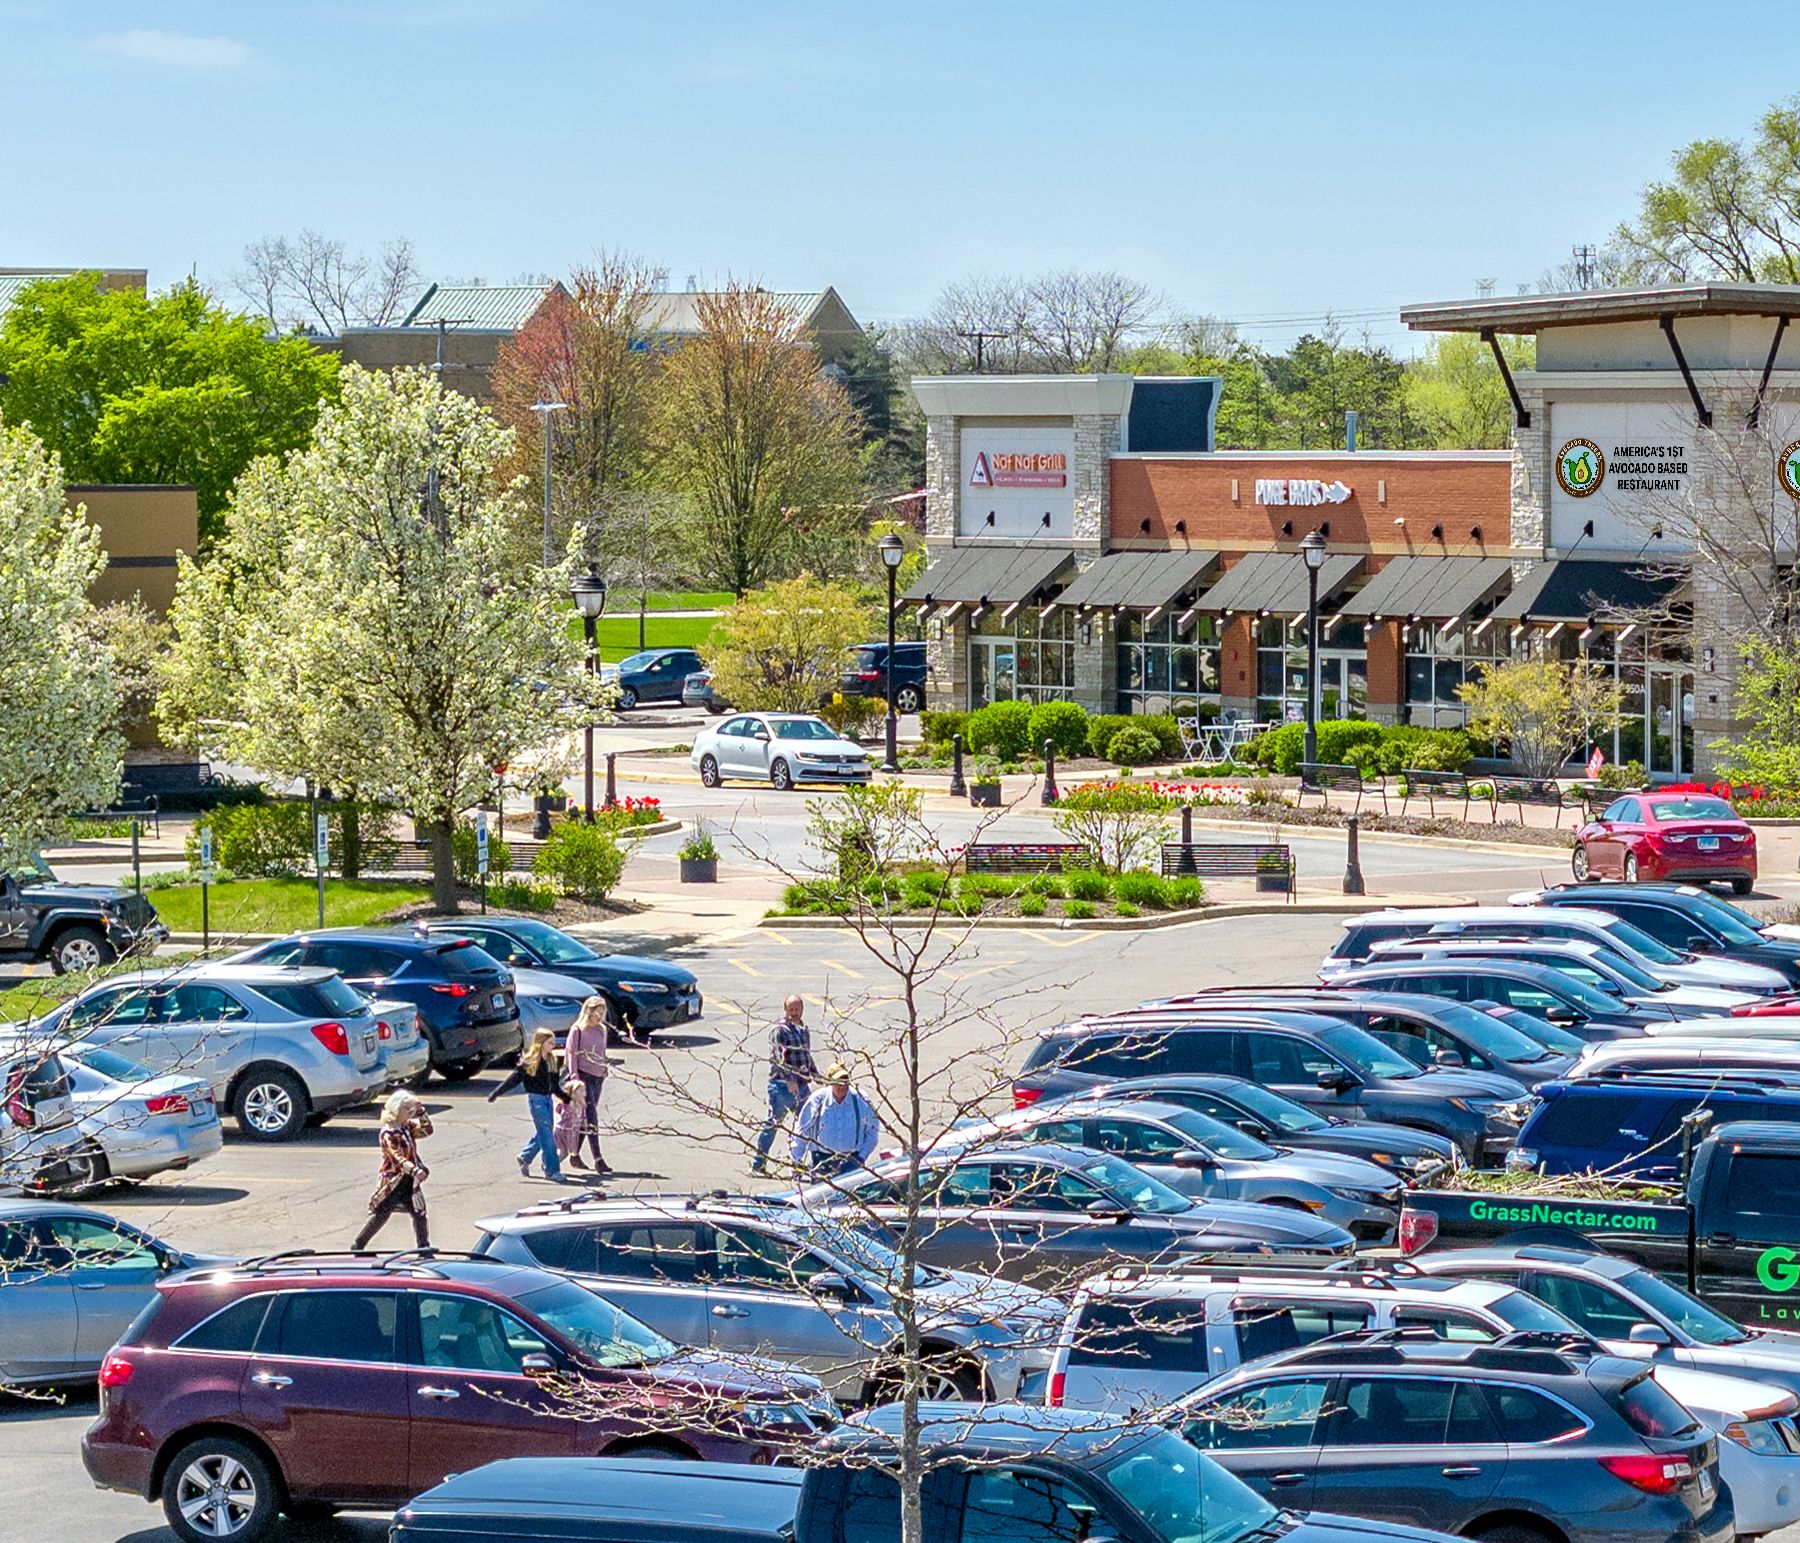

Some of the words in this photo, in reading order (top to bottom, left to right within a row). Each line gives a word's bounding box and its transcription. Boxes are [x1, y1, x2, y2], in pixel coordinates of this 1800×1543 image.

[1613, 446, 1665, 457] AMERICA'S
[1666, 446, 1685, 457] 1ST
[1039, 453, 1067, 470] Grill
[1608, 462, 1656, 474] AVOCADO
[1657, 462, 1688, 474] BASED
[1617, 479, 1681, 490] RESTAURANT
[1288, 479, 1321, 506] BROS
[1469, 1200, 1657, 1230] GrassNectar.com
